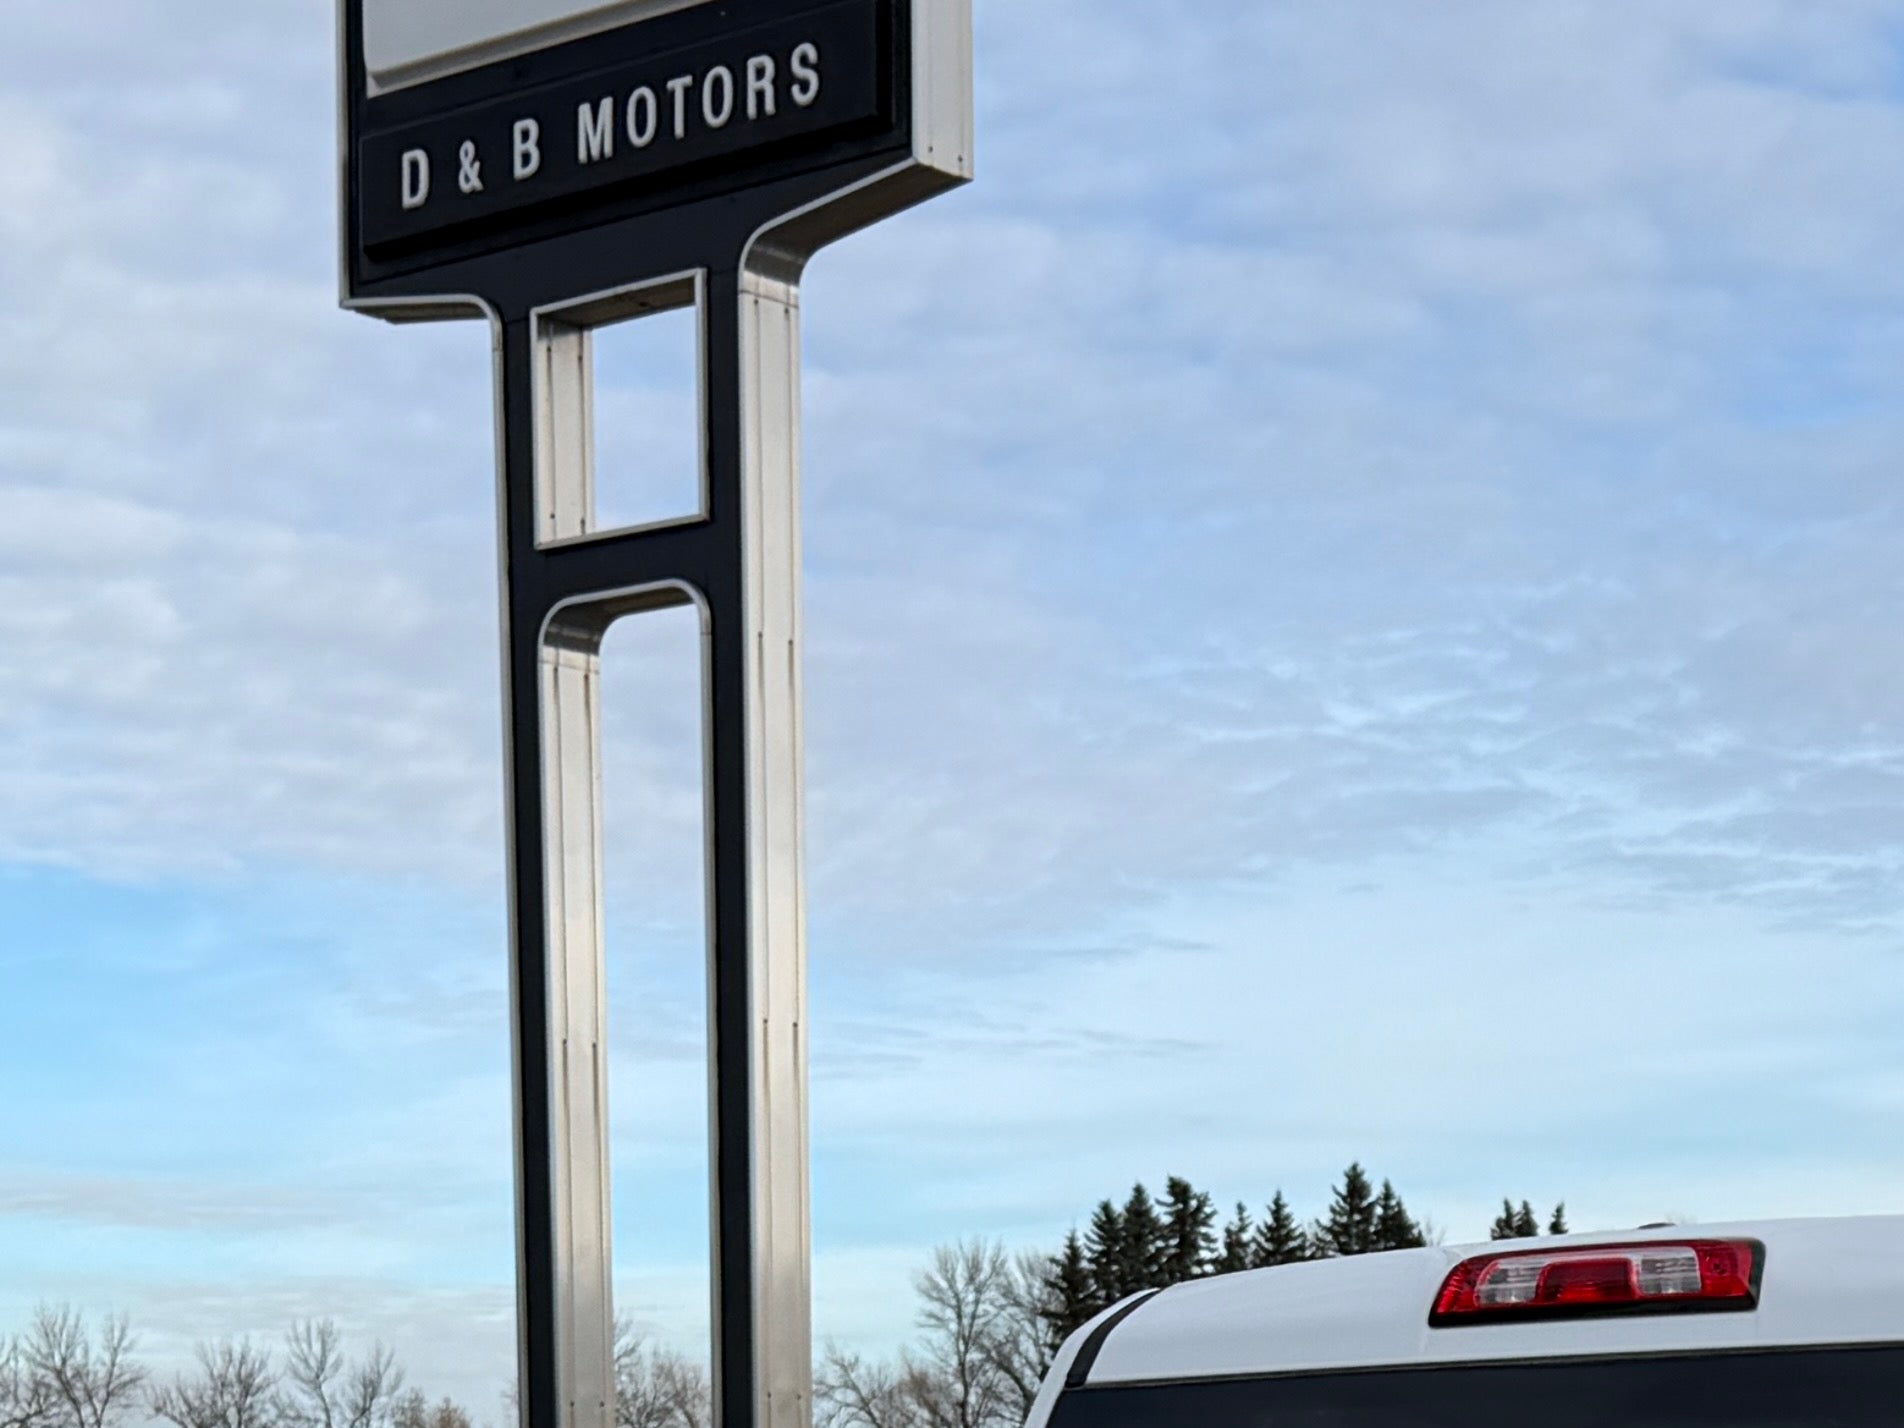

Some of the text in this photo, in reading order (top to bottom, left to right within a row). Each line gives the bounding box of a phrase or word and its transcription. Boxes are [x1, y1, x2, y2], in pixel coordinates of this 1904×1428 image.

[401, 41, 821, 210] D & B MOTORS
